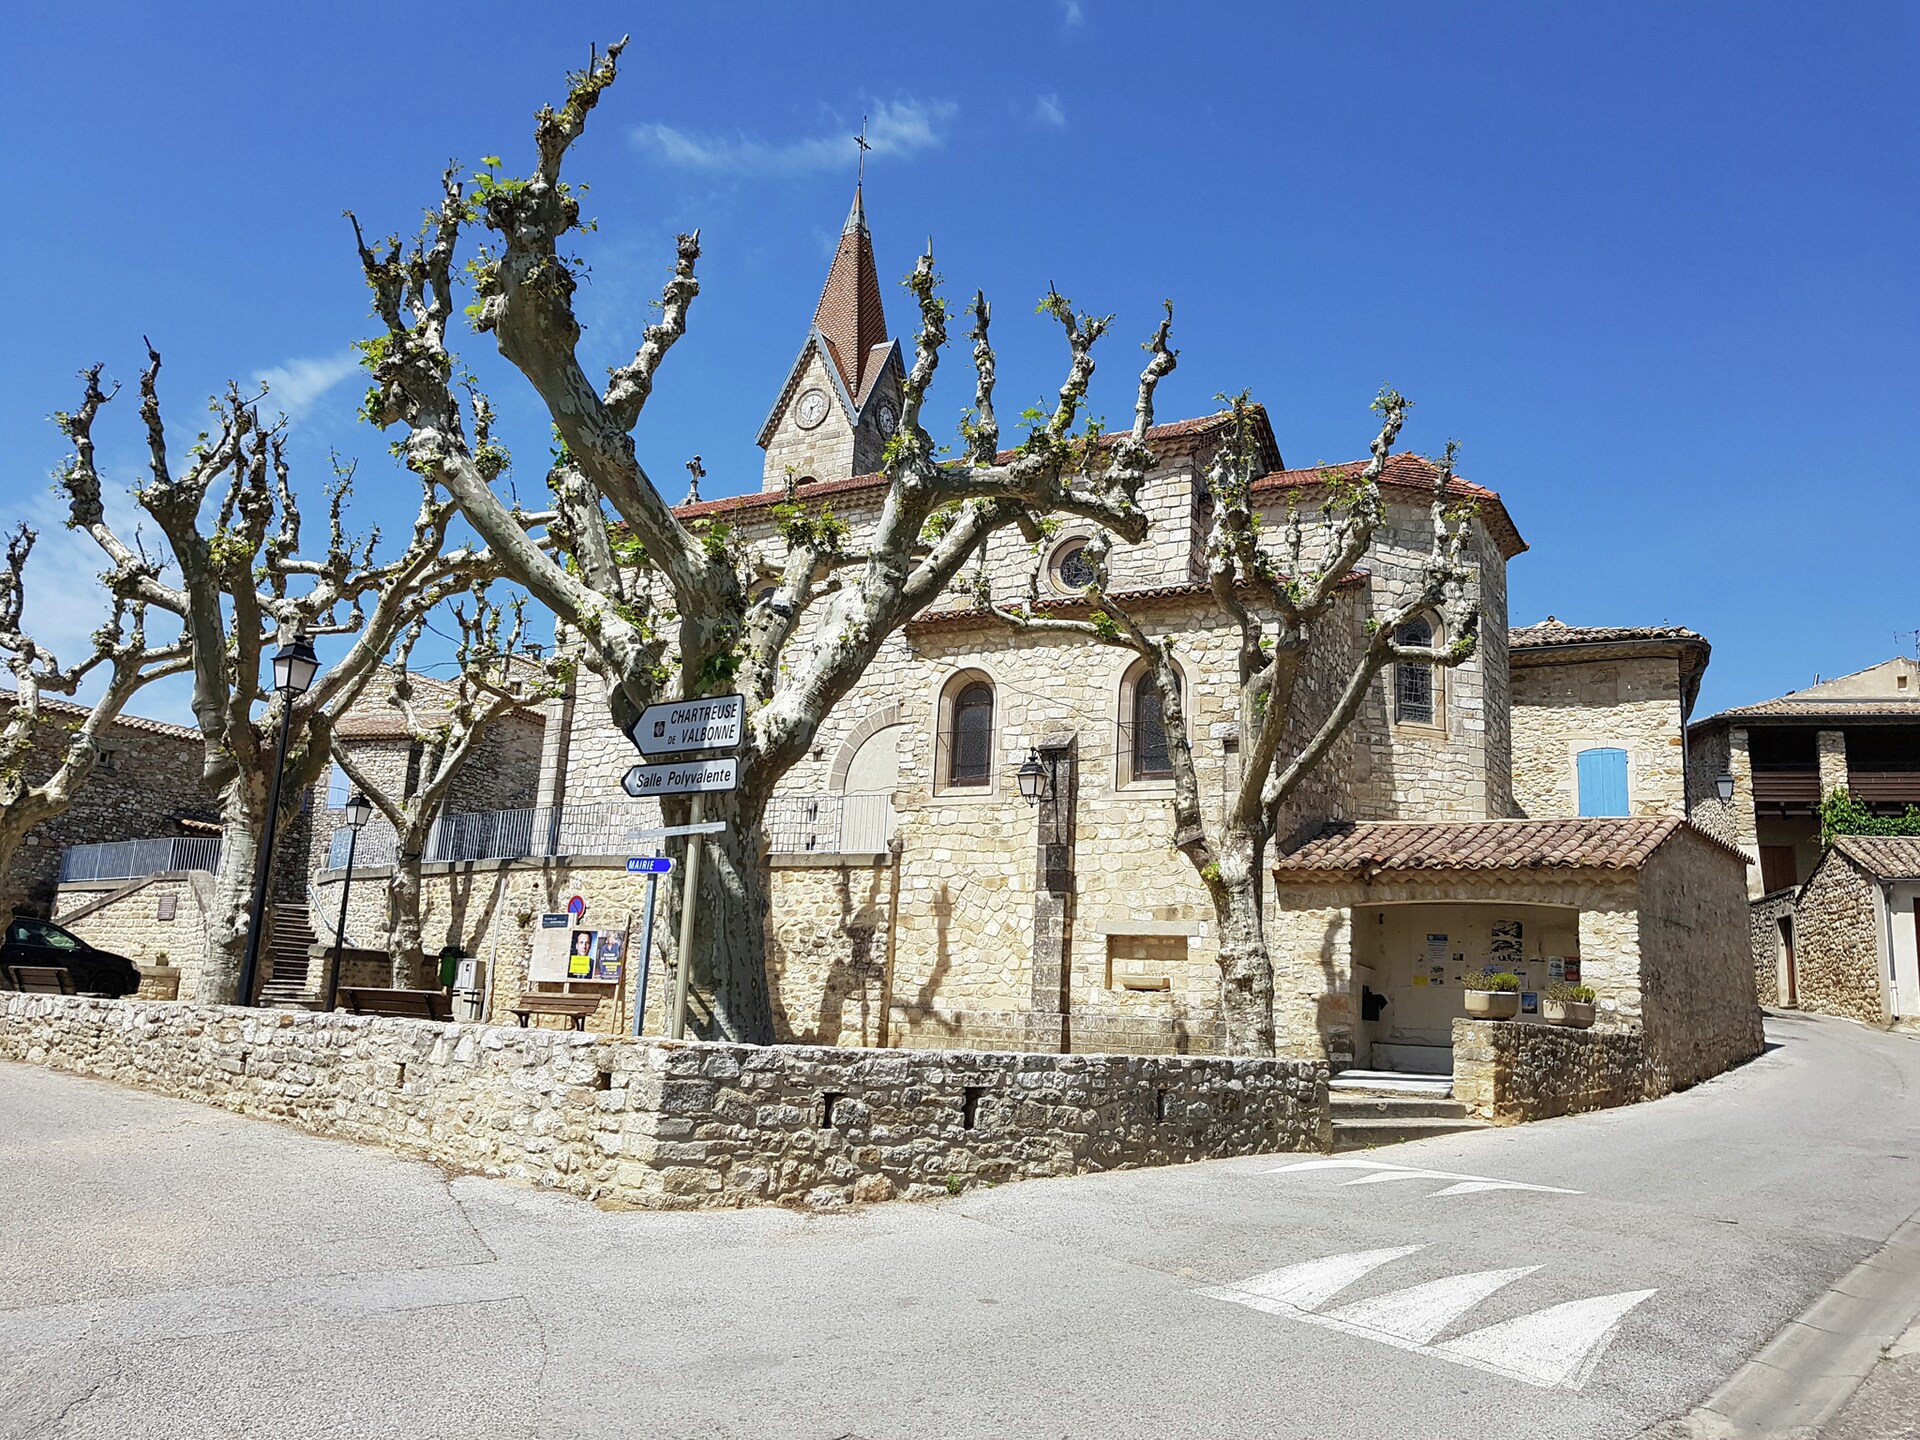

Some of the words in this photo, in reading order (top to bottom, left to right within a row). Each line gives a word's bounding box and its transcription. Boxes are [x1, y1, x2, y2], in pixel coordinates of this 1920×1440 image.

[671, 703, 738, 725] CHARTREUSE
[667, 735, 676, 745] DE
[681, 724, 736, 744] VALBONNE
[636, 773, 662, 788] Salle
[667, 768, 731, 788] Polyvalente
[628, 860, 654, 870] MAIRIE
